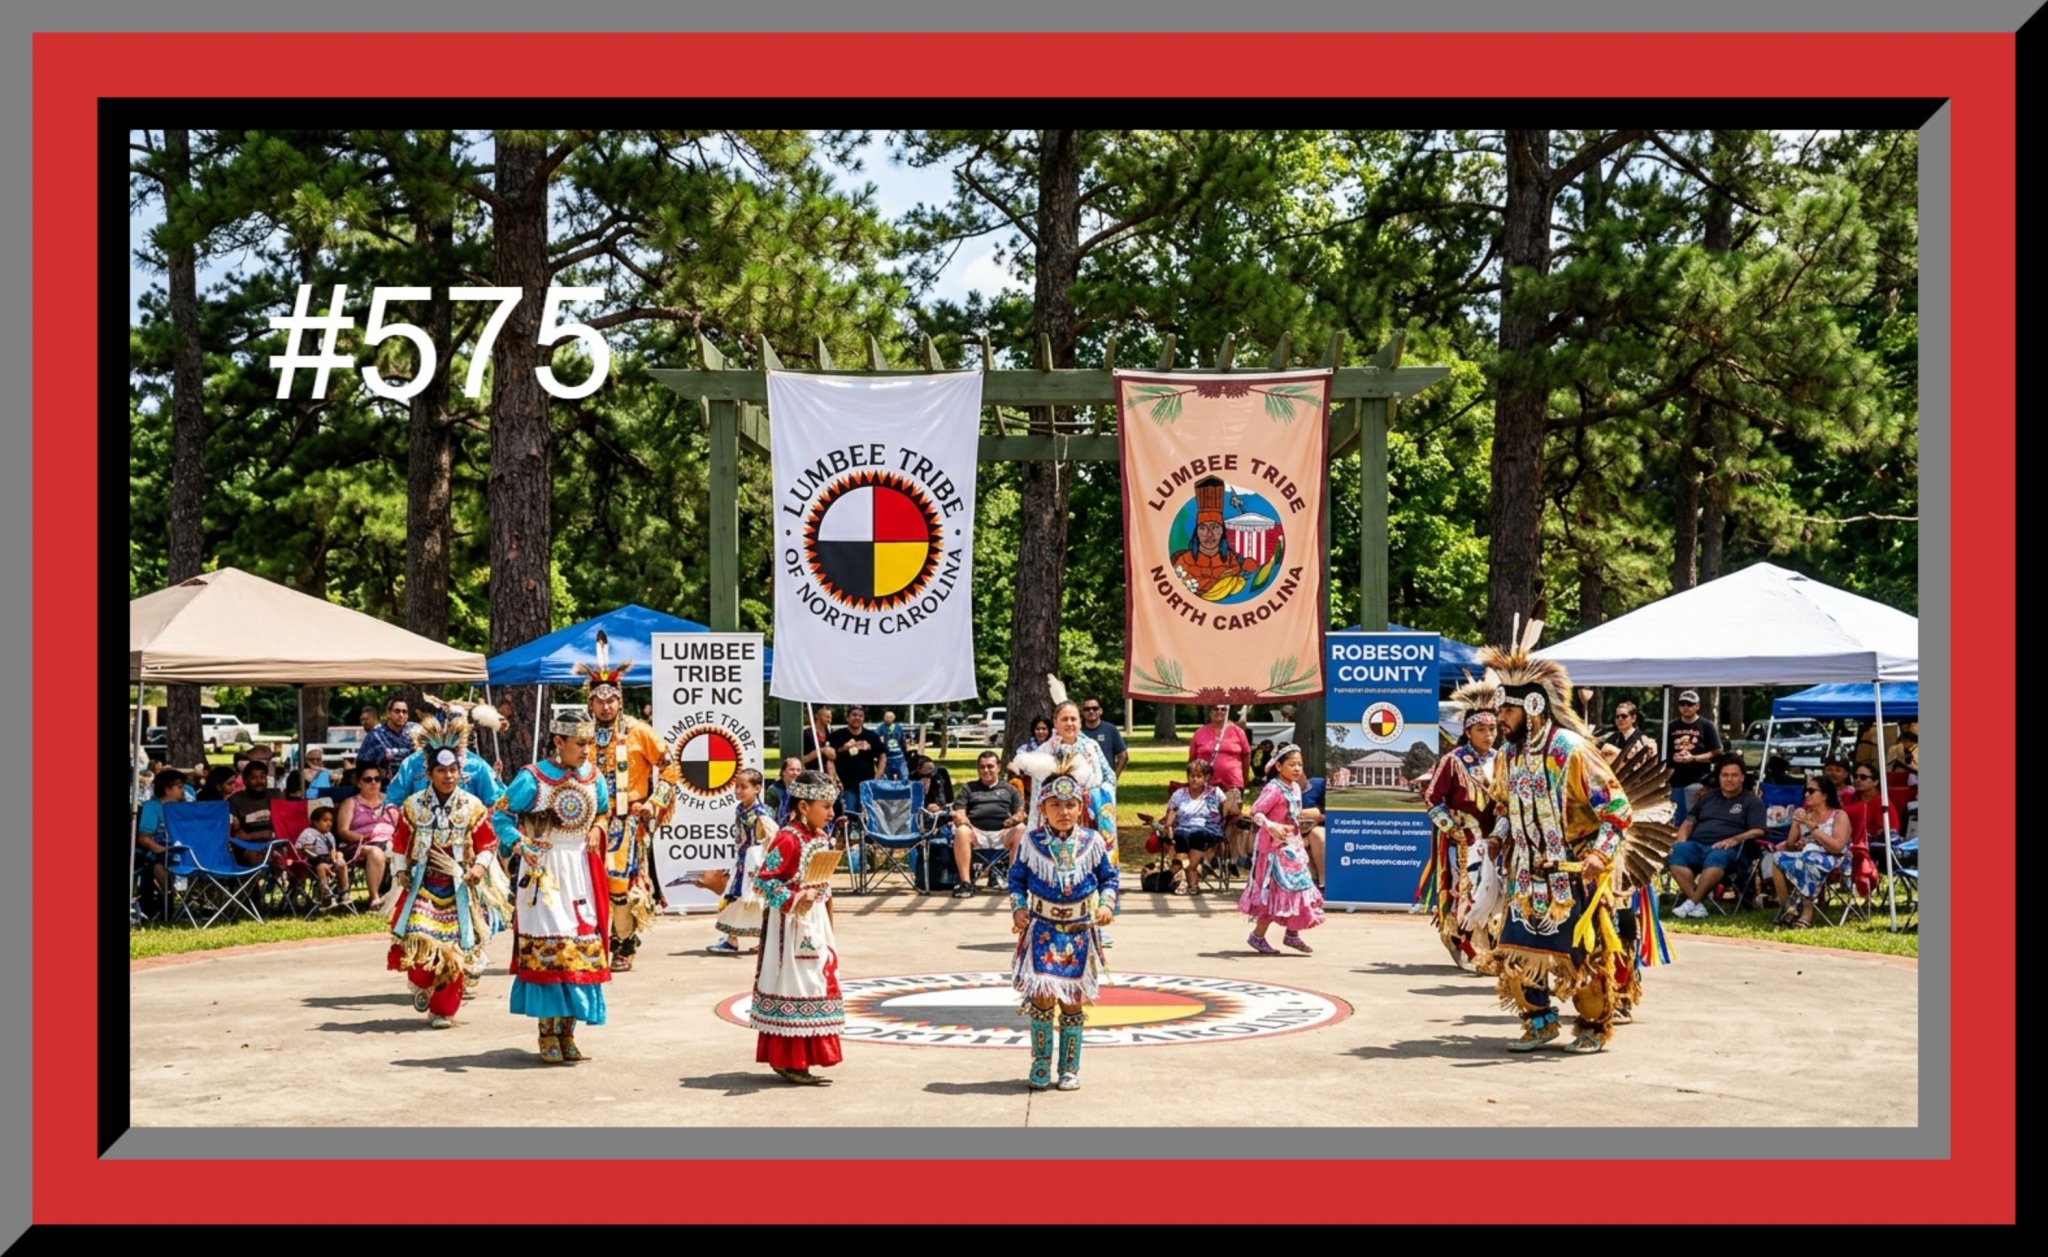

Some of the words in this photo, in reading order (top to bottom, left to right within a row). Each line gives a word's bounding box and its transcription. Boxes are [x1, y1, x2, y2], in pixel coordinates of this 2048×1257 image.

[783, 443, 887, 518] LUMBEE
[899, 447, 965, 519] TRIBE
[1147, 454, 1239, 513] LUMBEE
[1250, 457, 1307, 515] TRIBE
[785, 547, 807, 579] OF
[796, 581, 871, 636] NORTH
[878, 547, 964, 636] CAROLINA
[1150, 564, 1208, 628] NORTH
[1212, 565, 1304, 632] CAROLINA
[660, 642, 756, 661] LUMBEE
[1332, 644, 1435, 661] ROBESON
[673, 665, 742, 684] TRIBE
[1338, 665, 1428, 683] COUNTY
[672, 687, 704, 706] OF
[711, 687, 743, 706] NC
[708, 794, 736, 810] CAR
[668, 843, 737, 861] COUNT
[842, 1025, 1025, 1045] ORTH
